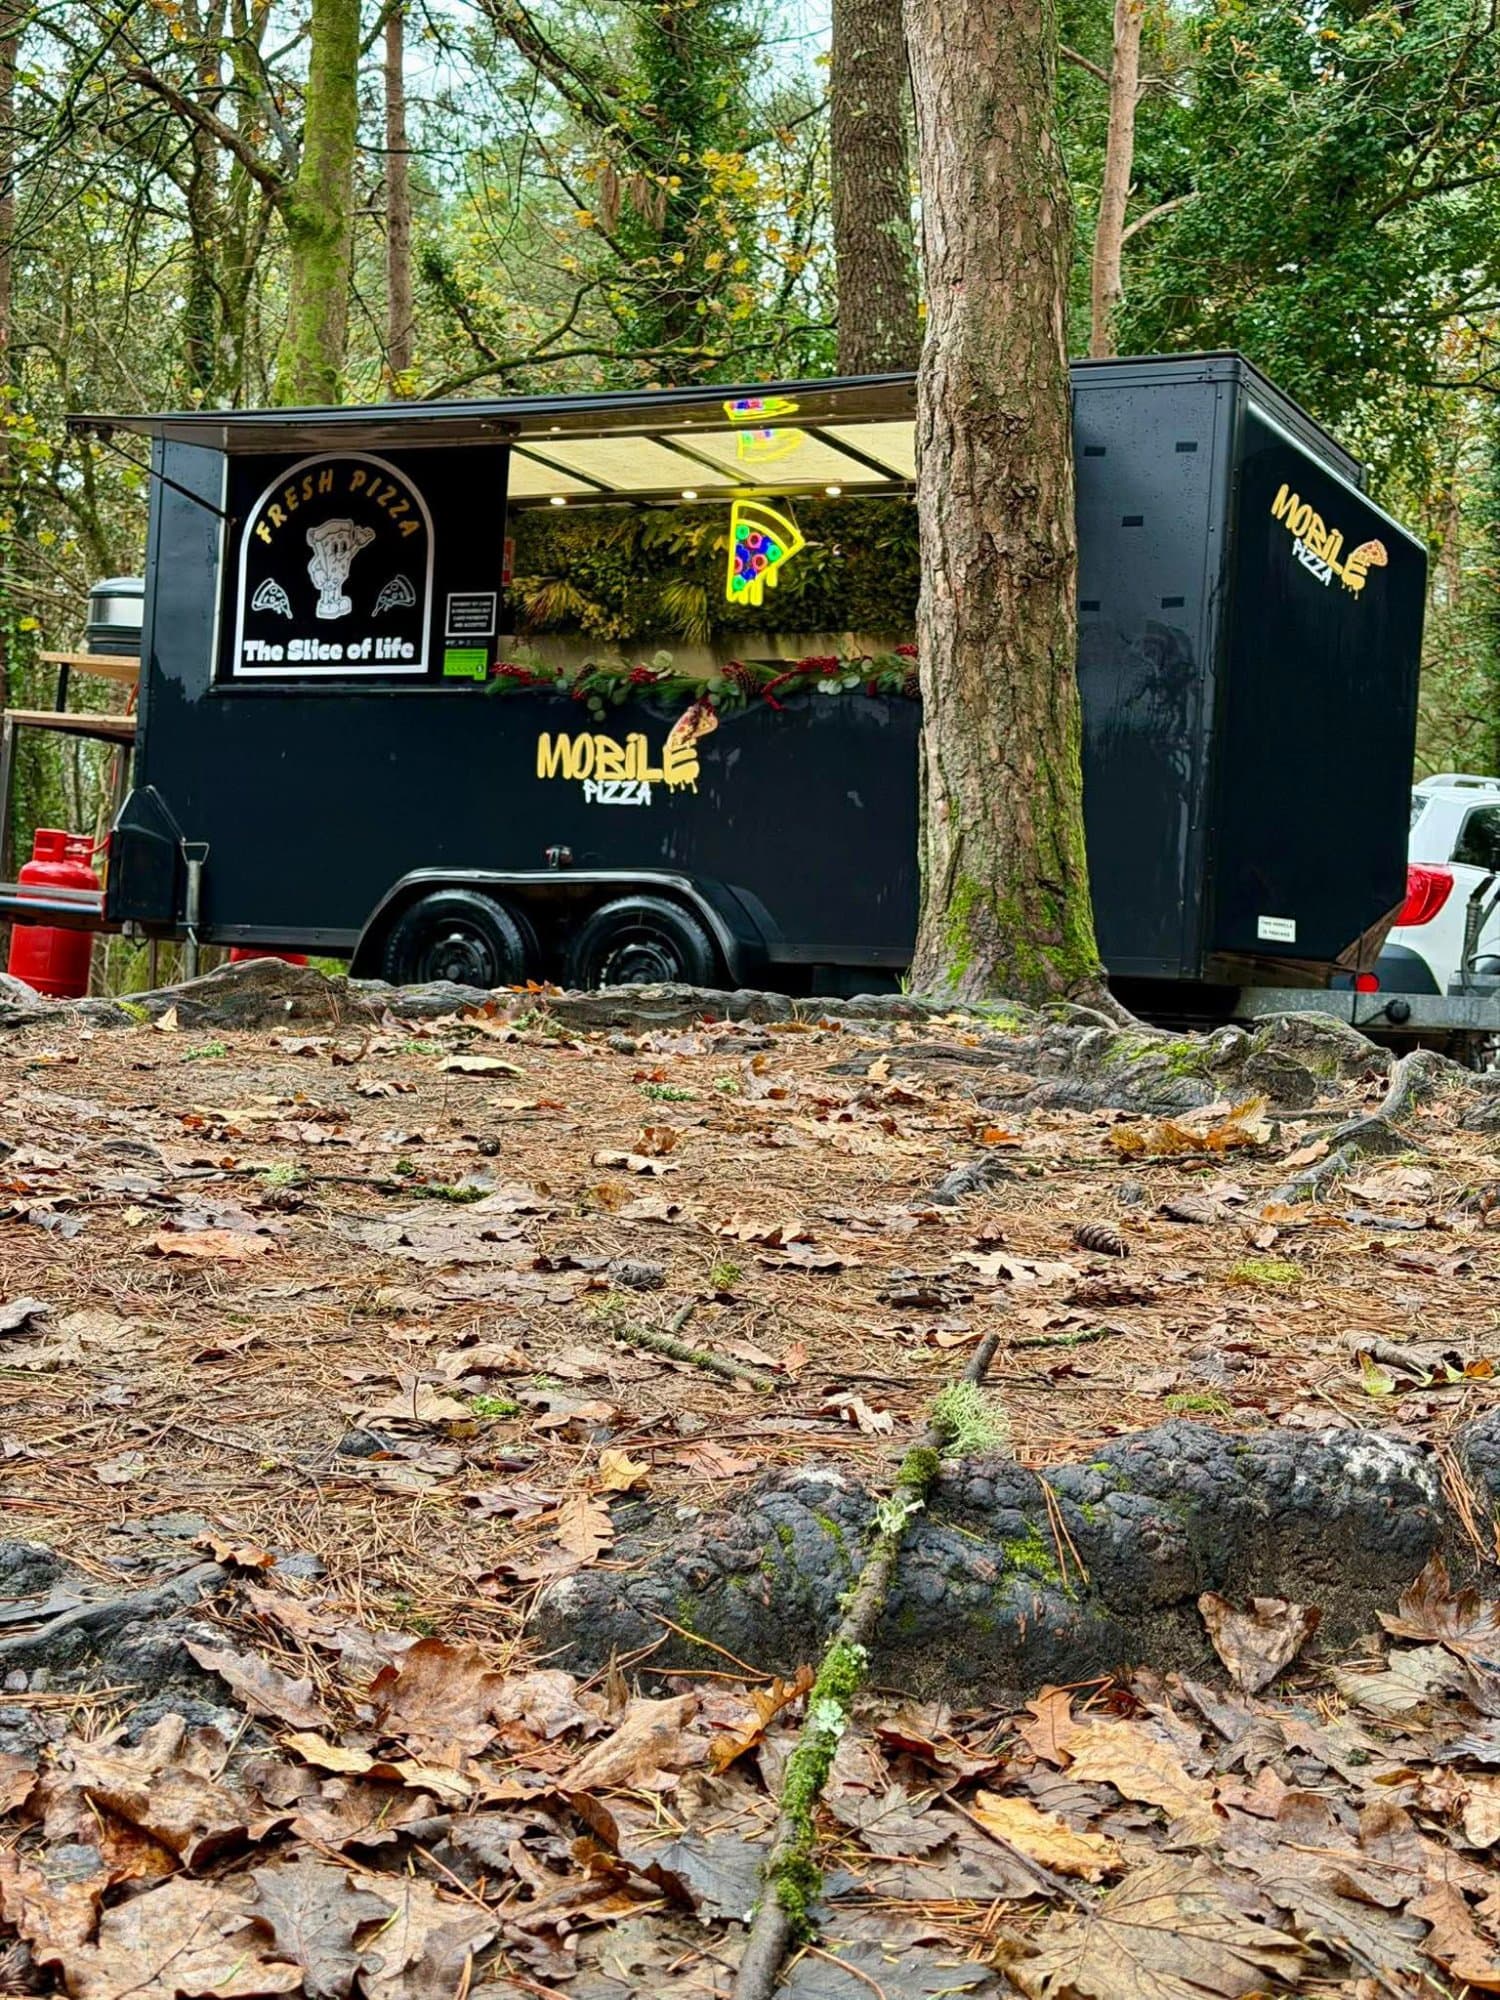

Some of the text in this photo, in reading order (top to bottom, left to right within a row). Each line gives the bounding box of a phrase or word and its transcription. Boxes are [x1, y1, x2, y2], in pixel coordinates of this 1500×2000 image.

[255, 468, 421, 544] FRESH PIZZA
[243, 639, 283, 662] The
[287, 638, 343, 661] Slice
[347, 637, 373, 661] of
